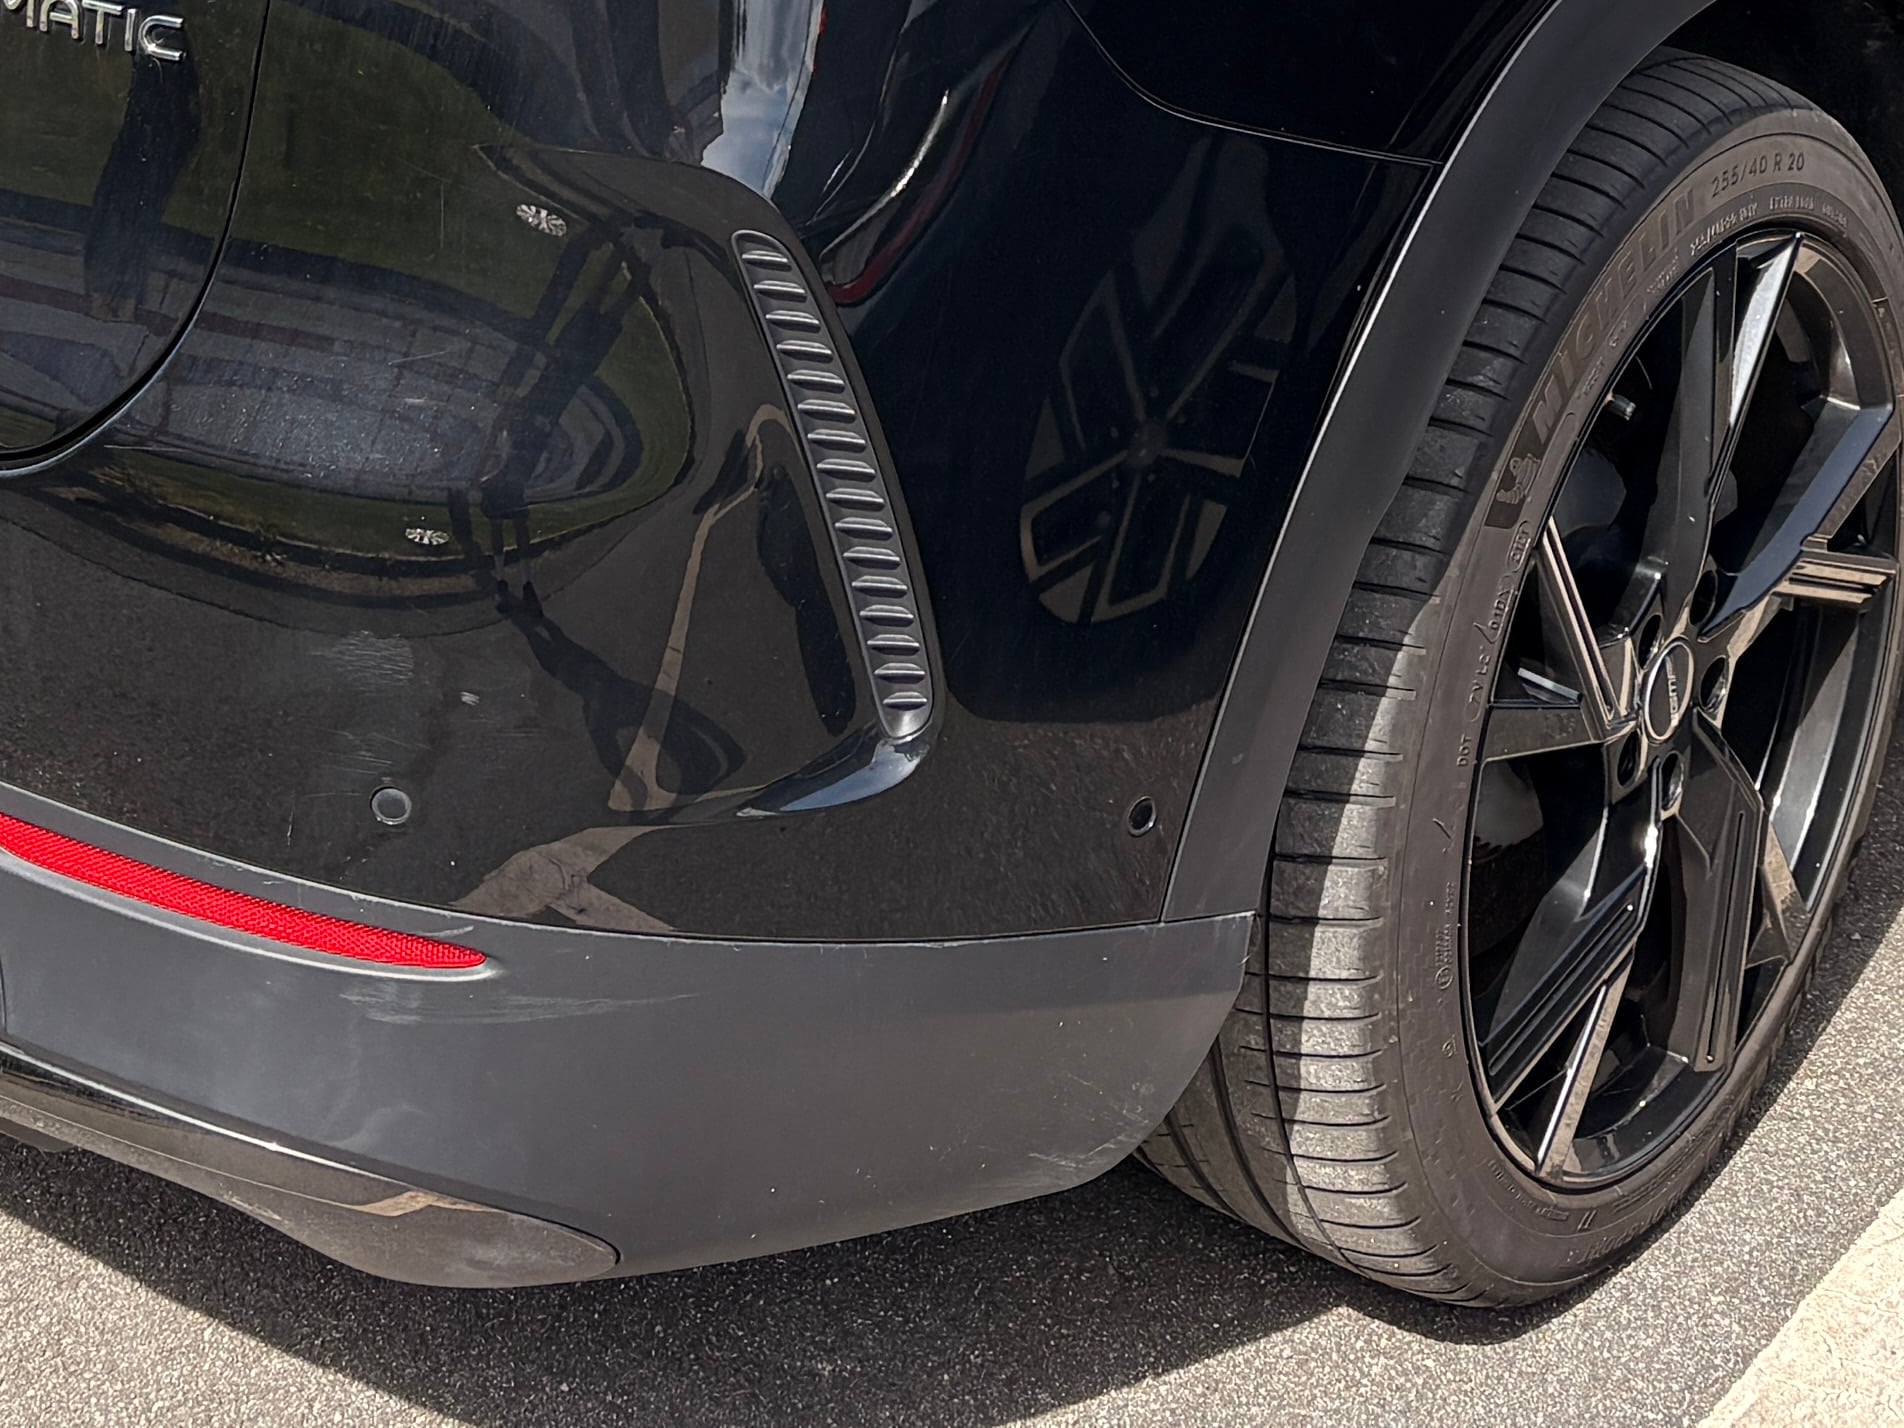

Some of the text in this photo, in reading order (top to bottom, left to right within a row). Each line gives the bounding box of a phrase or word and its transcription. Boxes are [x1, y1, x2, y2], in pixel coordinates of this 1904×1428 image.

[1711, 152, 1805, 197] 255/40 R 20
[1531, 188, 1694, 445] MICHELIN
